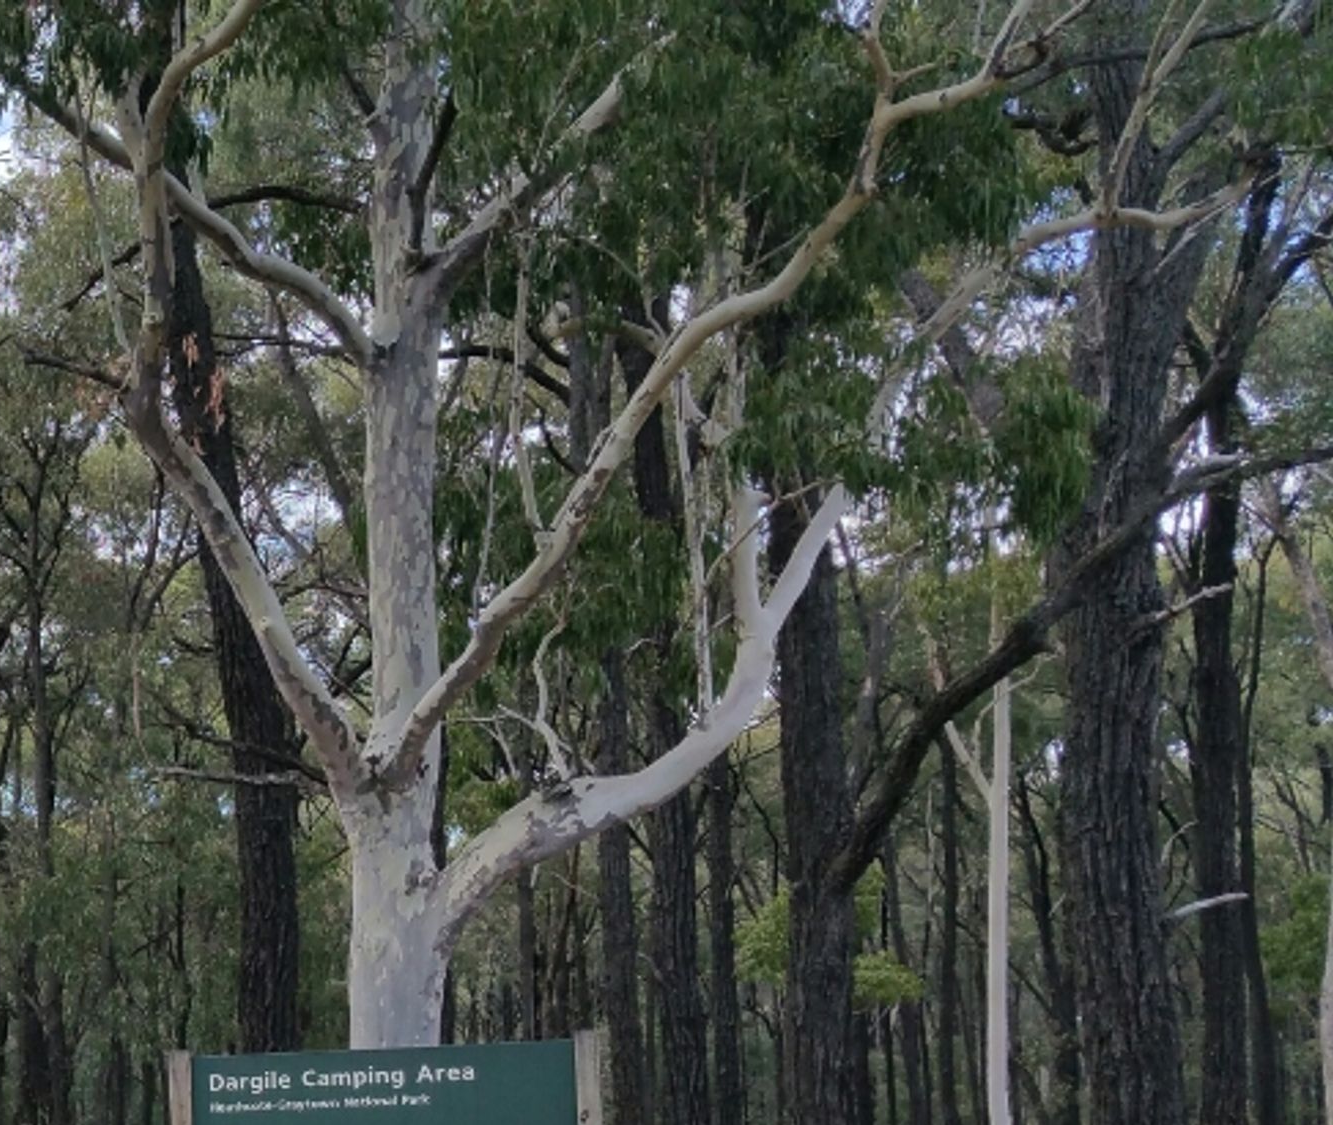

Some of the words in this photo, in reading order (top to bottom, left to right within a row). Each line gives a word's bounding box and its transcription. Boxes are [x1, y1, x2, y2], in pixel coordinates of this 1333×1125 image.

[209, 1071, 291, 1094] Dargile
[301, 1067, 404, 1089] Camping
[416, 1064, 475, 1083] Area
